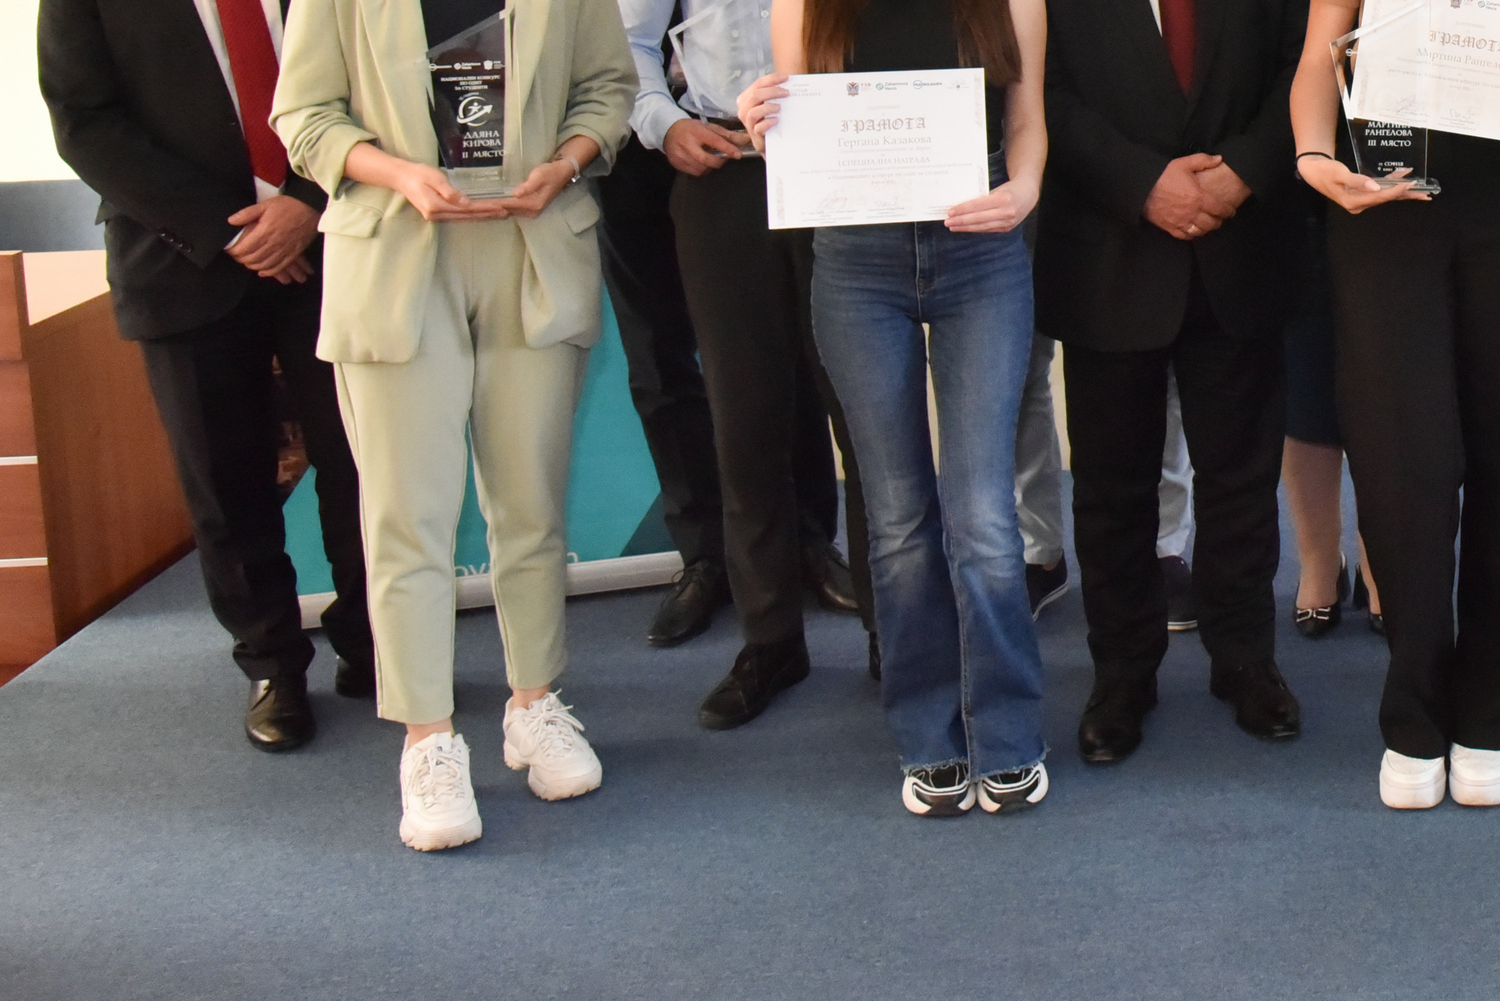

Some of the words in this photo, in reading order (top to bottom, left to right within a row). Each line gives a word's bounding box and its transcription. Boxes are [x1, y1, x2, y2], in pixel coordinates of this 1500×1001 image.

[840, 117, 926, 133] ГРАМОТА
[463, 130, 500, 140] ДАЯНА
[462, 139, 502, 148] КИРОВА
[838, 137, 880, 149] Гергана
[883, 135, 932, 146] Казакова
[473, 150, 506, 158] МЯСТО
